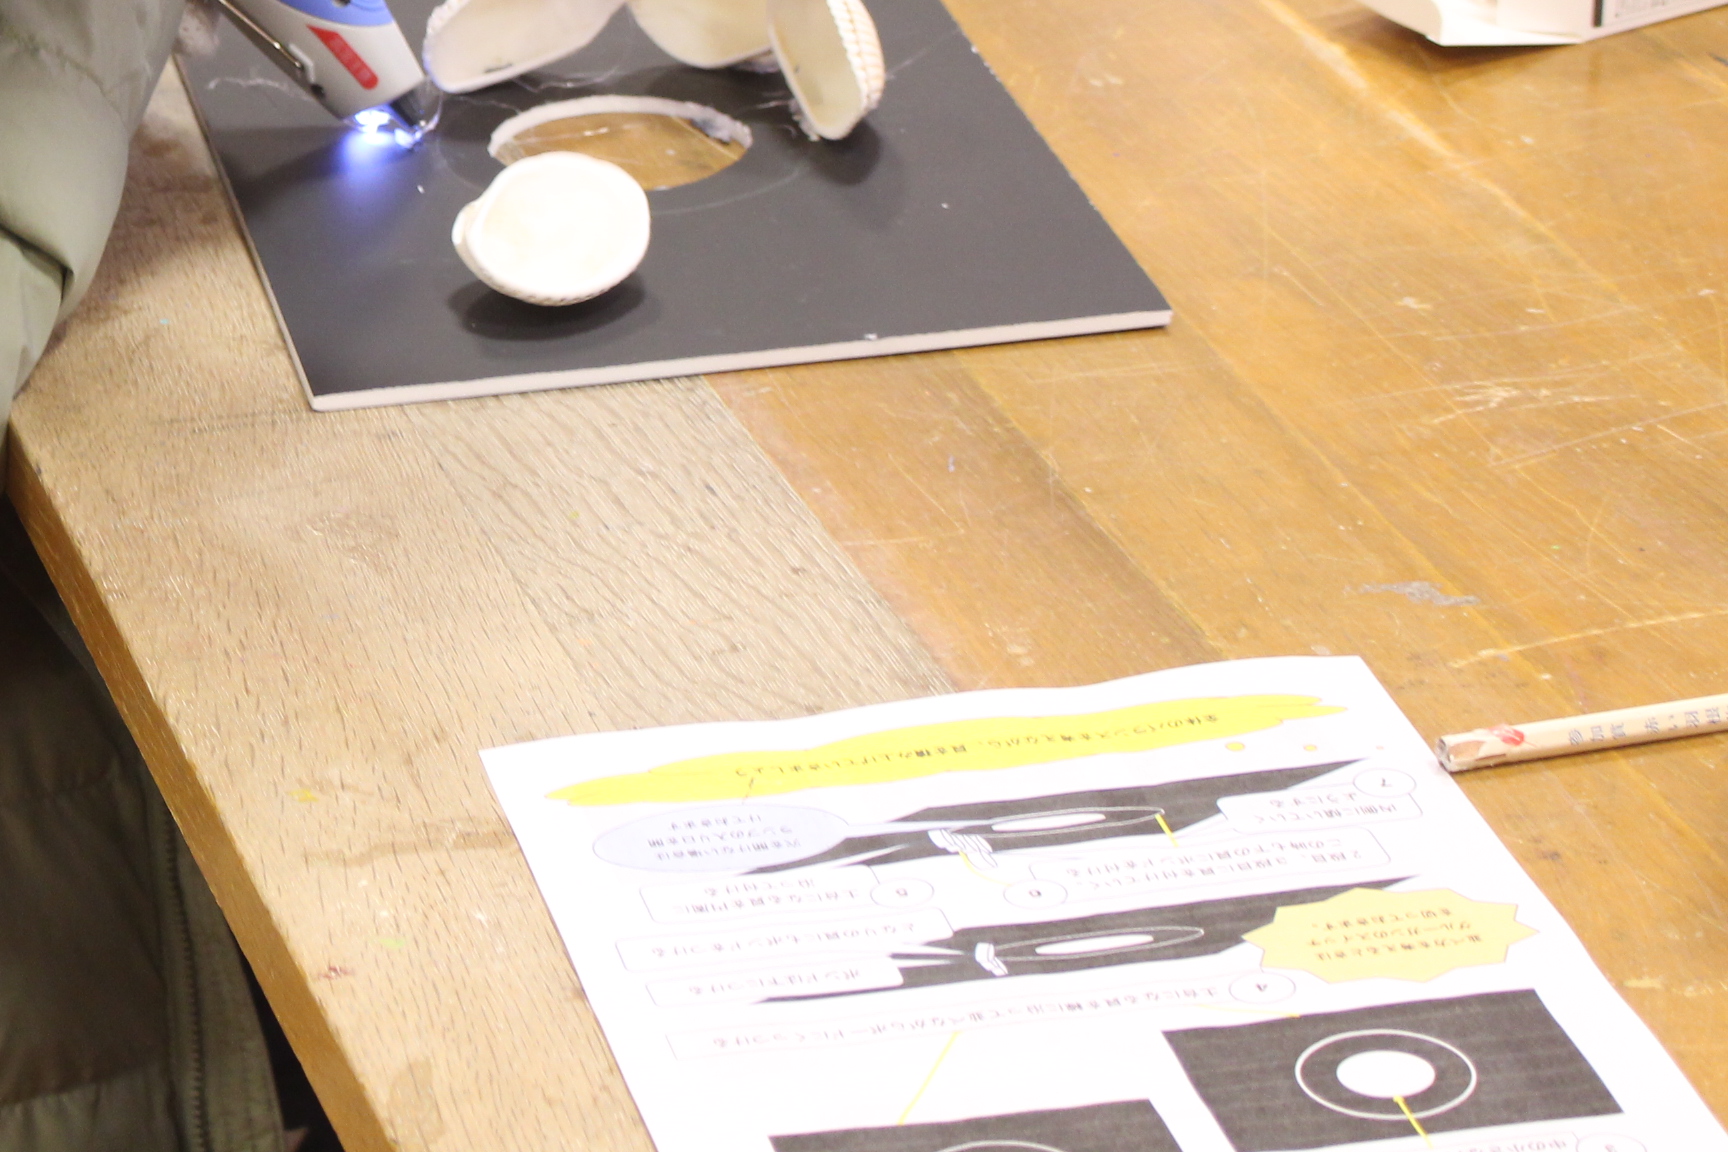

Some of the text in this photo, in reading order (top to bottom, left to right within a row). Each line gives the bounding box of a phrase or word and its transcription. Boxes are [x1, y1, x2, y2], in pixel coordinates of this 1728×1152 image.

[1568, 721, 1626, 746] 参加賞
[1380, 777, 1391, 787] 7
[1269, 792, 1357, 808] ようにする
[1305, 921, 1472, 947] グルーガンのスイッチ
[1315, 934, 1482, 961] 並べ方を考えるときは
[688, 968, 860, 996] ボンドは下につける
[1255, 983, 1269, 994] 4
